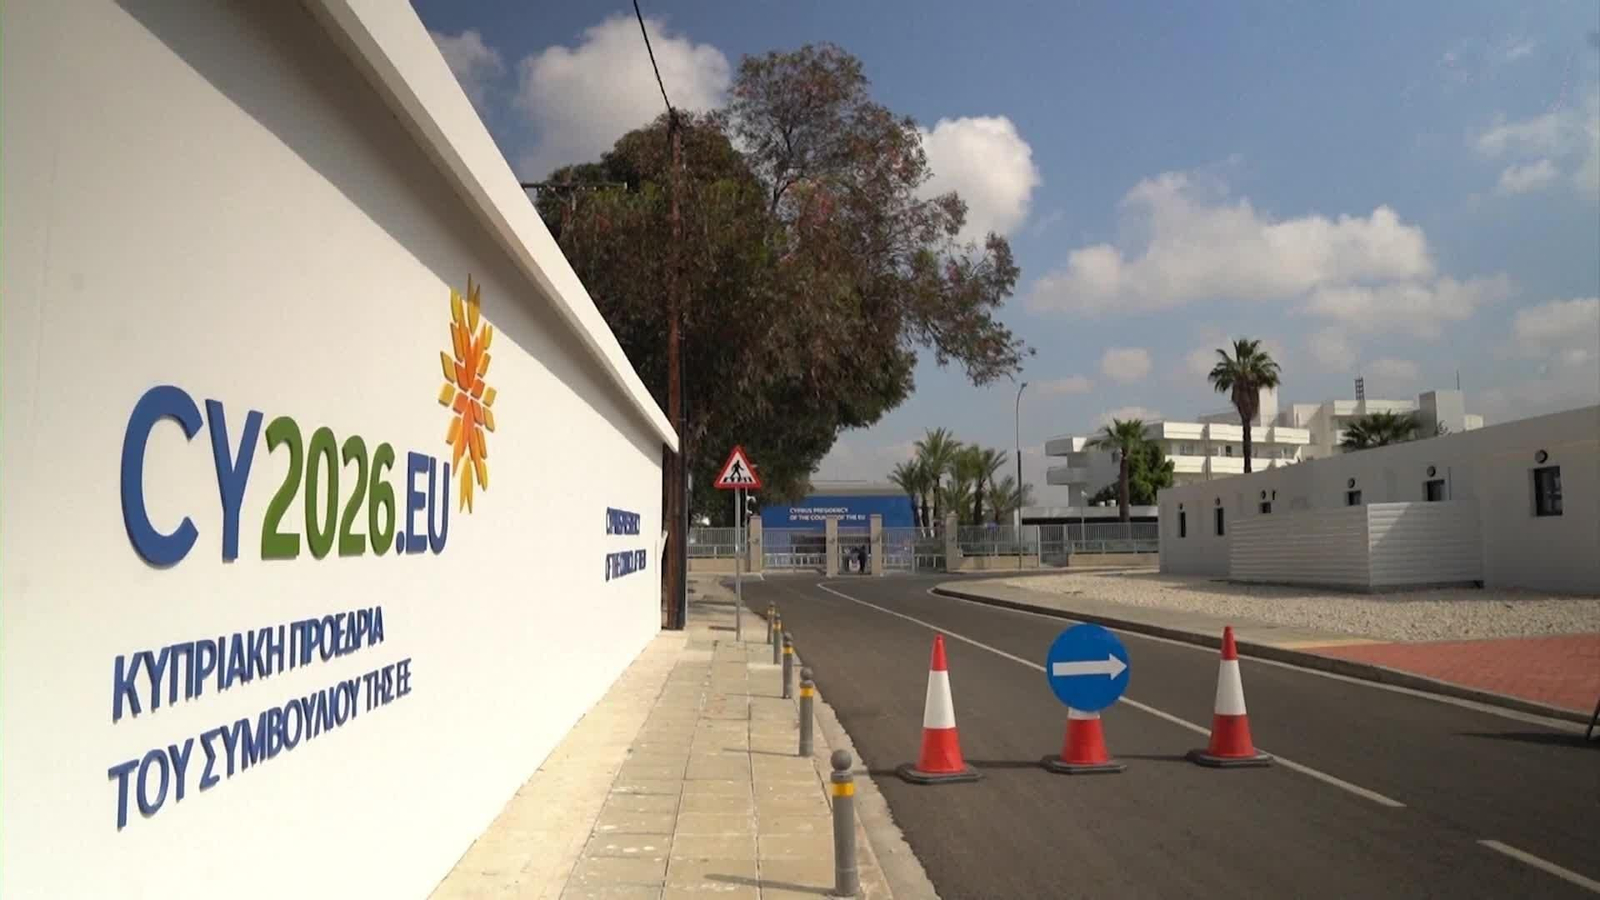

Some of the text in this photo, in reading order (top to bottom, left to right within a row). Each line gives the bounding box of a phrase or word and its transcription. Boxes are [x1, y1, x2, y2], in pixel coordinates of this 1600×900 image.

[120, 384, 450, 569] CY2026.EU
[108, 737, 195, 832] ΤΟΥ
[199, 676, 361, 793] ΣΥΜΒΟΥΛΙΟΥ
[362, 663, 395, 713] ΤΗΣ
[112, 605, 384, 724] ΚΥΠΡΙΑΚΗ ΠΡΟΕΔΡΙΑ
